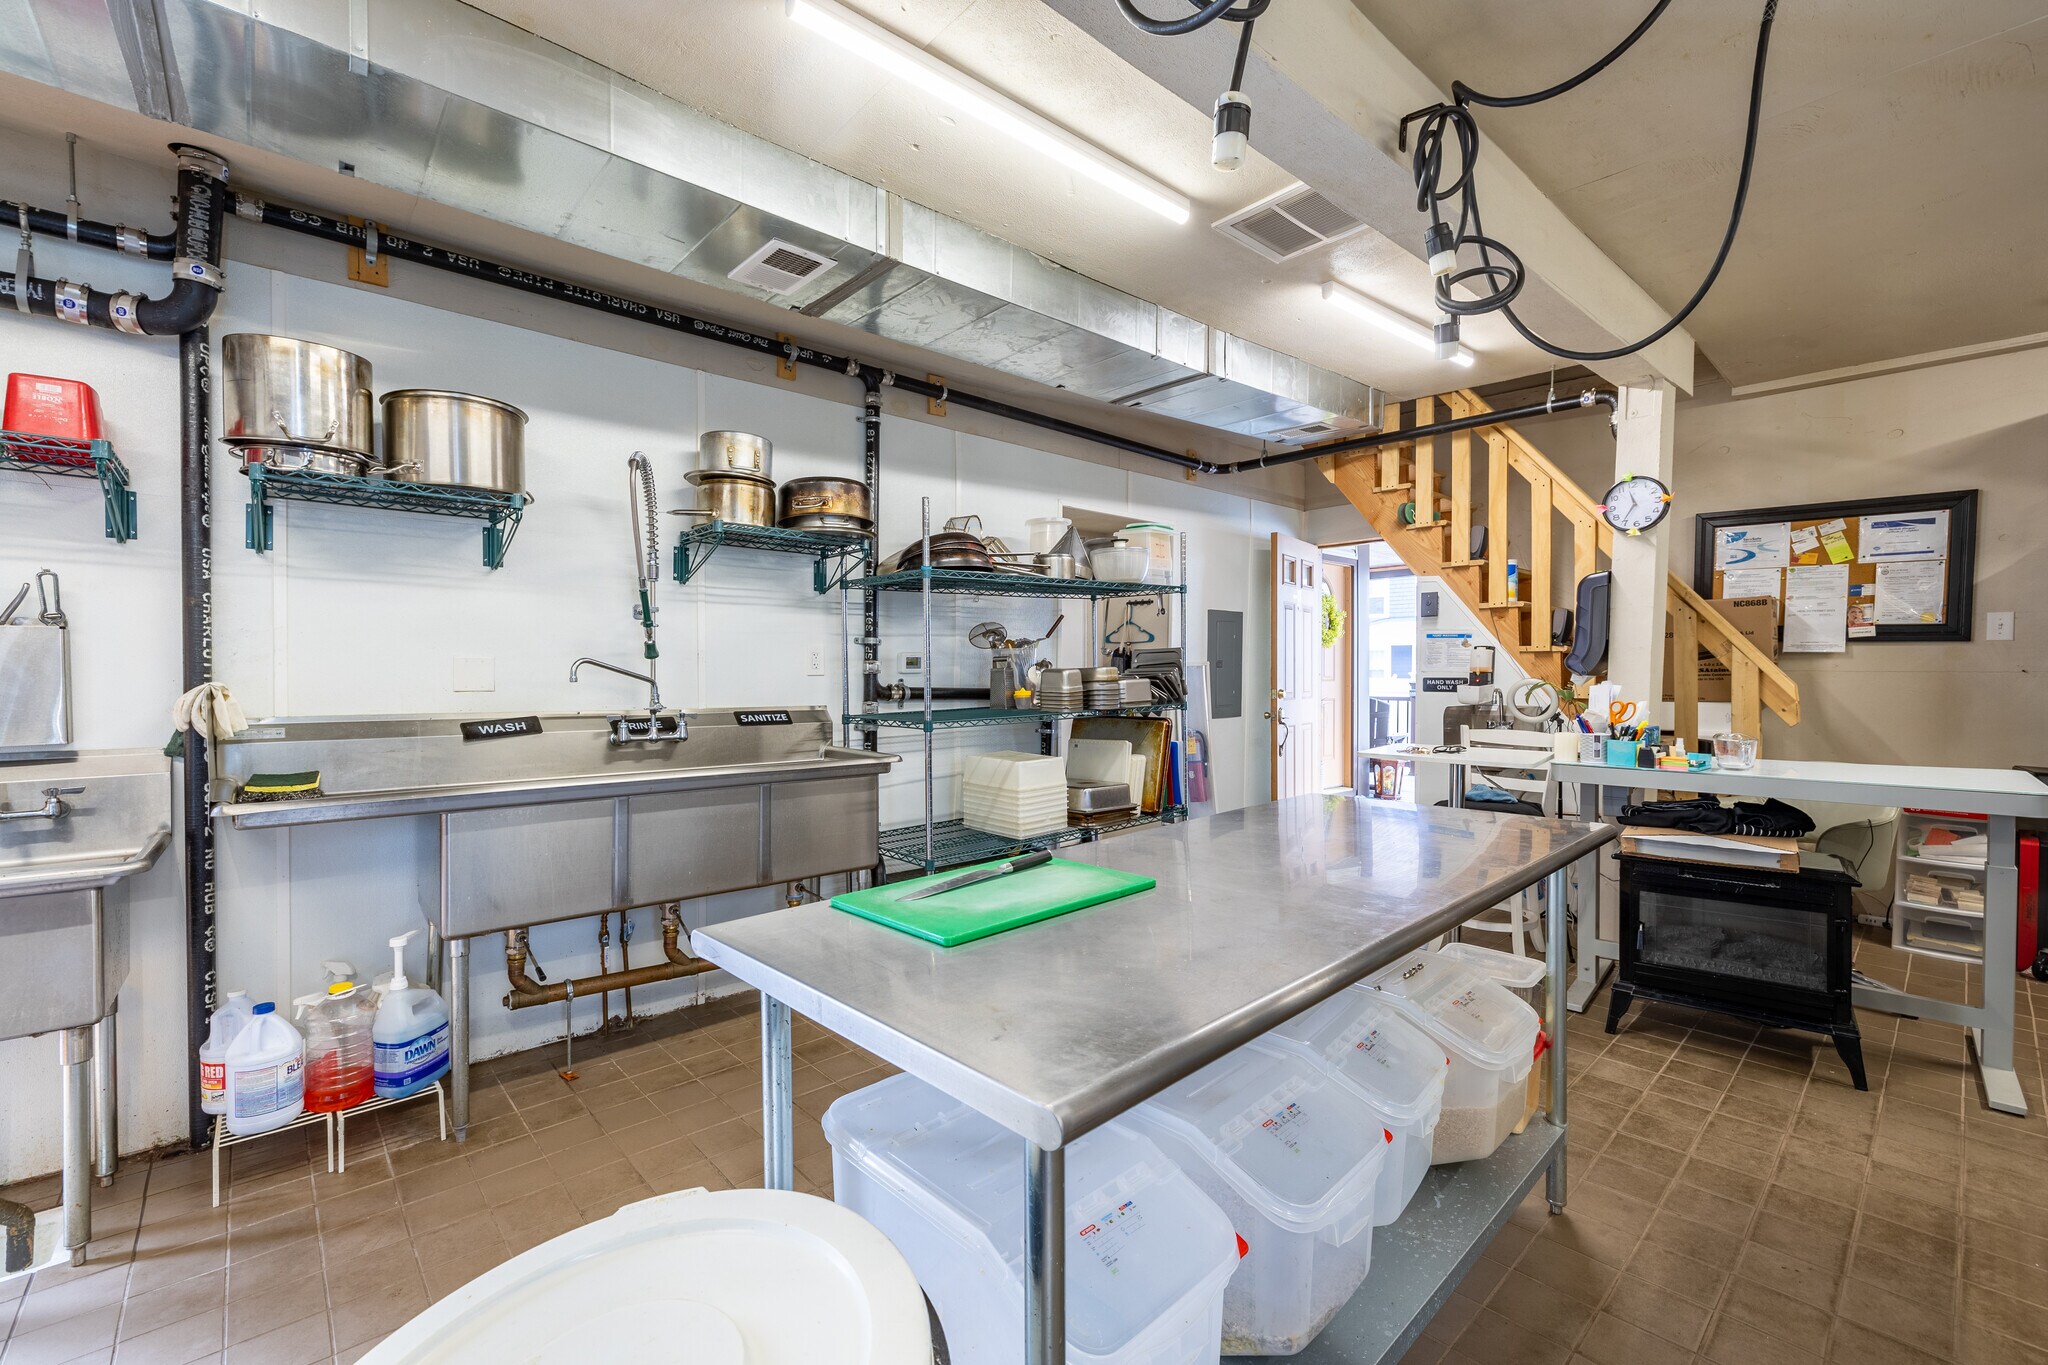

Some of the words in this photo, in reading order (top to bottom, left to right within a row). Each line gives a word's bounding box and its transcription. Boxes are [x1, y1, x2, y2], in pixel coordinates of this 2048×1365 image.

[447, 251, 480, 270] USA
[564, 283, 648, 314] CHARLOTTE
[1650, 487, 1658, 495] 2
[1733, 599, 1768, 608] NC868B
[202, 592, 213, 685] CHARLOTT
[739, 712, 789, 724] SANITIZE
[477, 721, 527, 735] WASH
[404, 1039, 436, 1062] DAWN
[205, 1066, 224, 1079] RED
